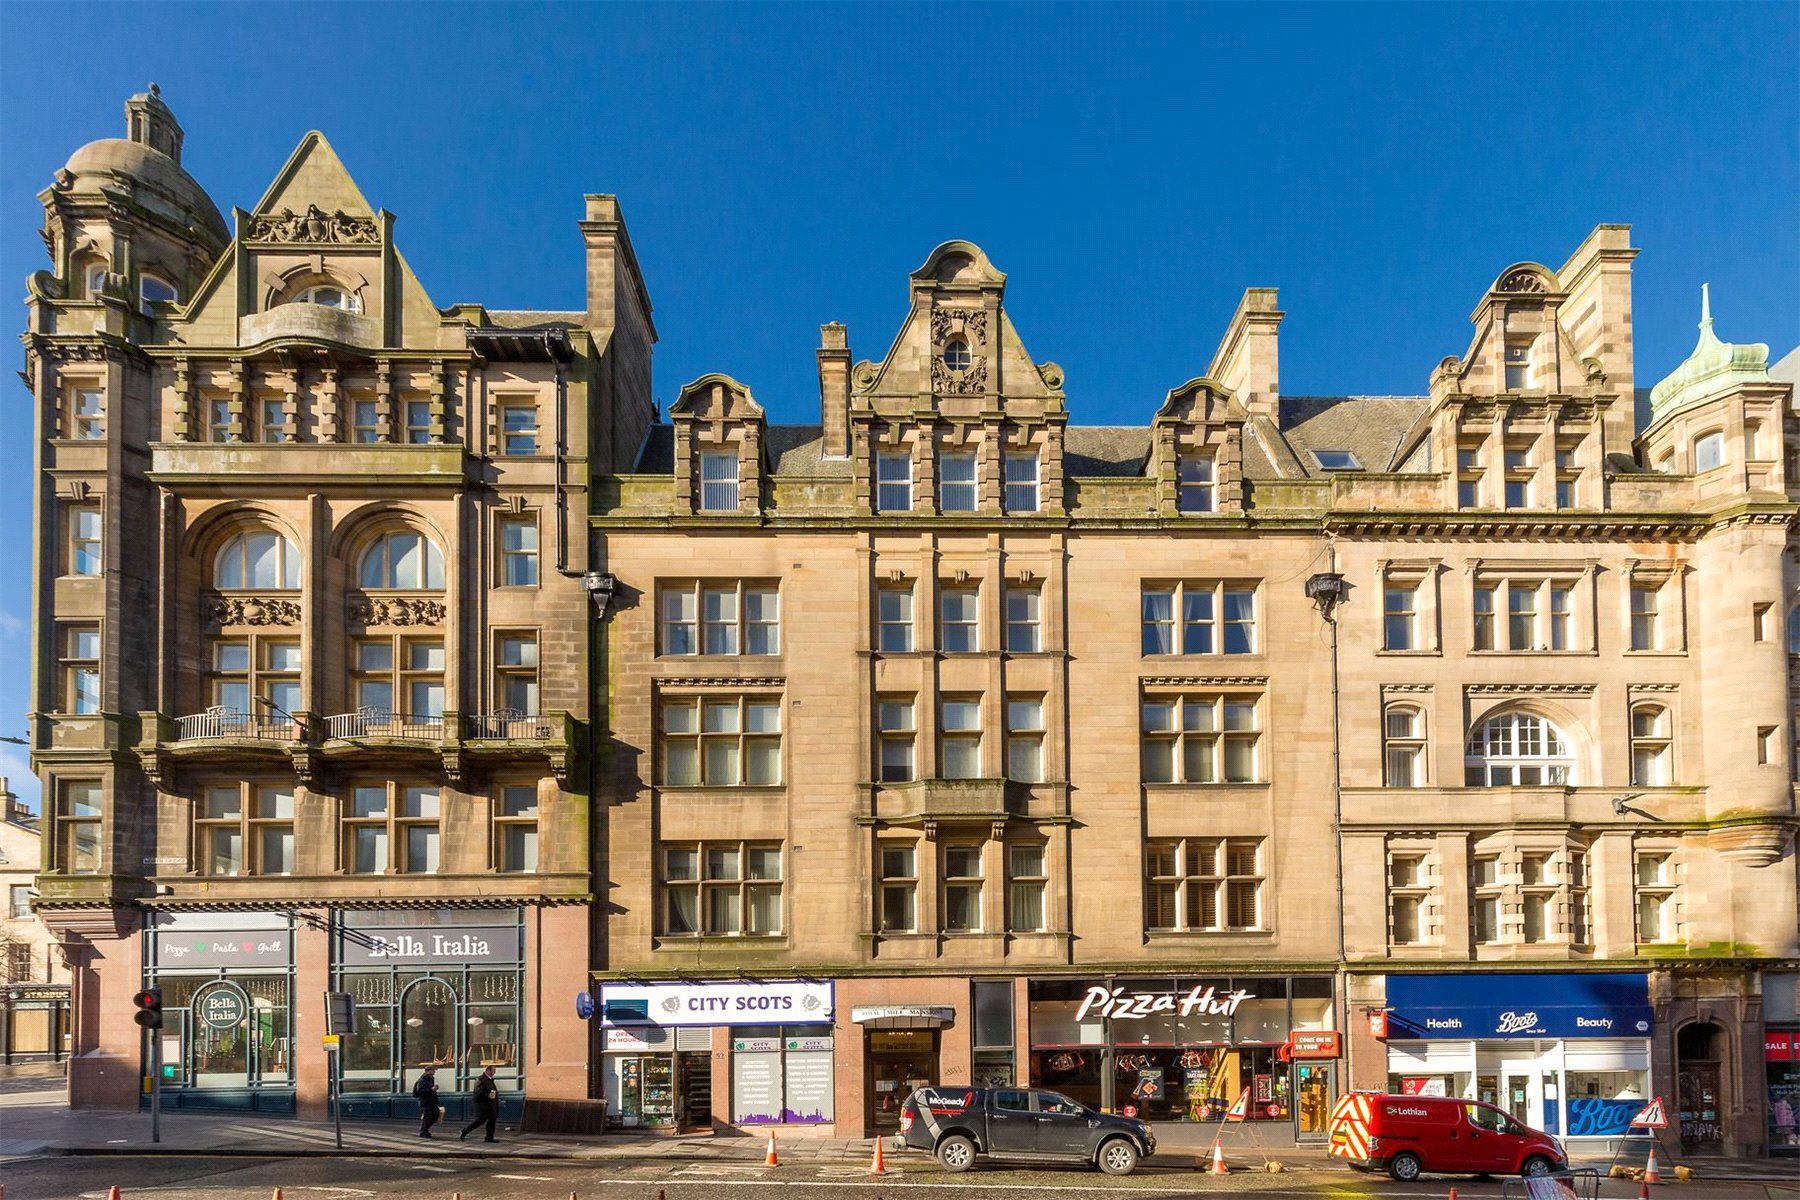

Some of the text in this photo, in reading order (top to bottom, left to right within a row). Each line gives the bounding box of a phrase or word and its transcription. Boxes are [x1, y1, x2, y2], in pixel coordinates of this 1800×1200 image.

[165, 943, 190, 957] Pizza
[212, 942, 239, 953] Pasta
[257, 941, 282, 954] Grill
[368, 934, 490, 958] Bella Italia
[208, 998, 236, 1009] Bella
[688, 996, 793, 1011] CITY SCOTS
[1075, 985, 1256, 1022] Pizza Hut
[208, 1010, 237, 1021] Italia
[1426, 1018, 1462, 1029] Health
[1496, 1012, 1538, 1033] Boots
[1576, 1017, 1613, 1029] Beauty
[1398, 1107, 1428, 1116] Lothian
